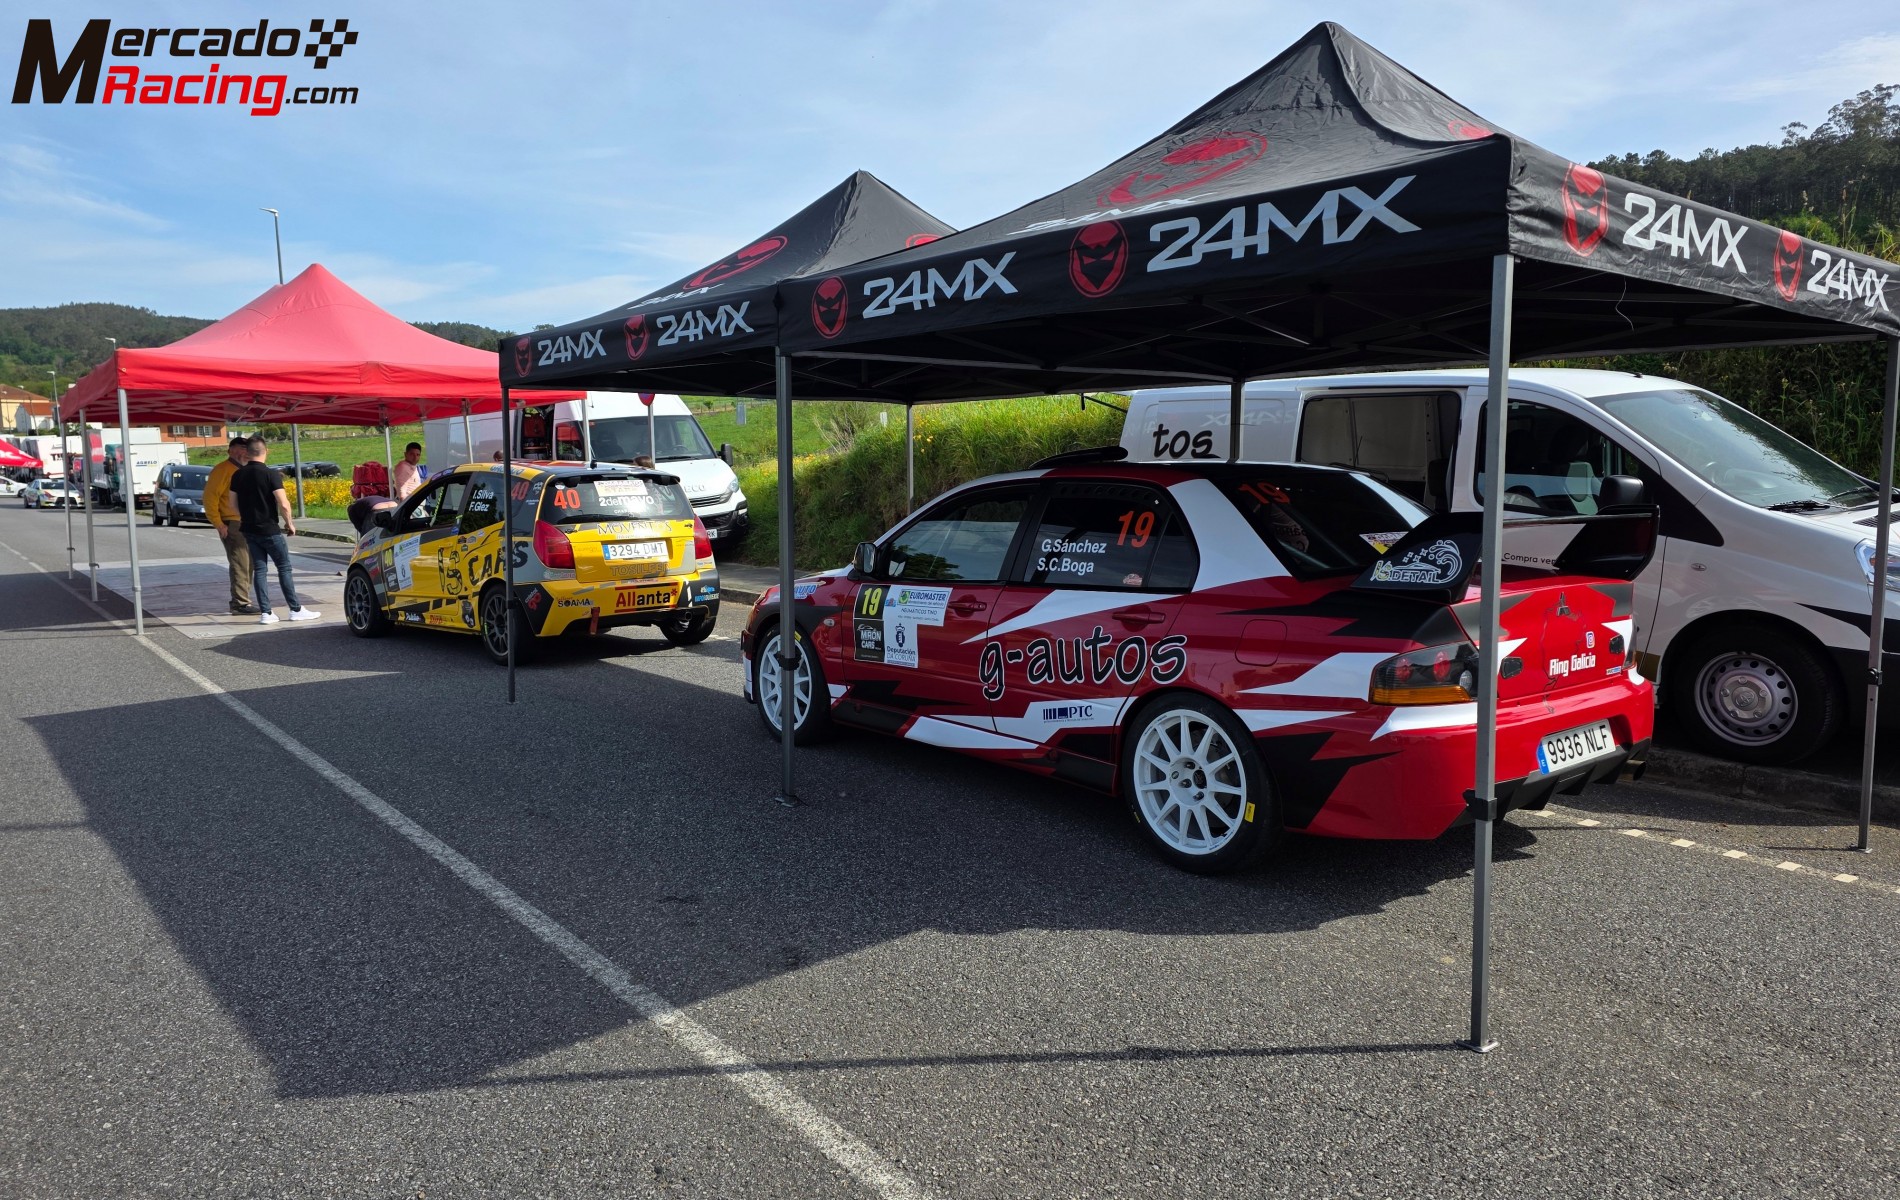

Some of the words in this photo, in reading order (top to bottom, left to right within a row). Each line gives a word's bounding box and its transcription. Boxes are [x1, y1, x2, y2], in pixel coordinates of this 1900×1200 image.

[1146, 175, 1423, 272] 24MX
[1622, 192, 1749, 274] 24MX
[862, 251, 1019, 319] 24MX
[1806, 249, 1890, 312] 24MX
[657, 300, 754, 347] 24MX
[537, 328, 606, 367] 24MX
[511, 481, 530, 500] 40
[553, 488, 581, 510] 40
[1238, 481, 1290, 504] 19
[469, 501, 490, 512] F.Glez
[1117, 511, 1156, 548] 19
[610, 546, 640, 557] 3294
[644, 542, 664, 555] DMT
[1041, 538, 1107, 554] G.Sánchez
[1037, 557, 1095, 576] S.C.Boga
[1503, 552, 1538, 564] Compra
[862, 587, 882, 616] 19
[909, 591, 946, 601] EUROMASTER
[861, 640, 876, 650] CARS
[978, 625, 1188, 701] g-autos
[1550, 657, 1569, 677] Ring
[1570, 653, 1596, 672] Galicia
[1069, 705, 1093, 718] PTC
[1547, 733, 1583, 764] 9936
[1583, 724, 1608, 753] NLF
